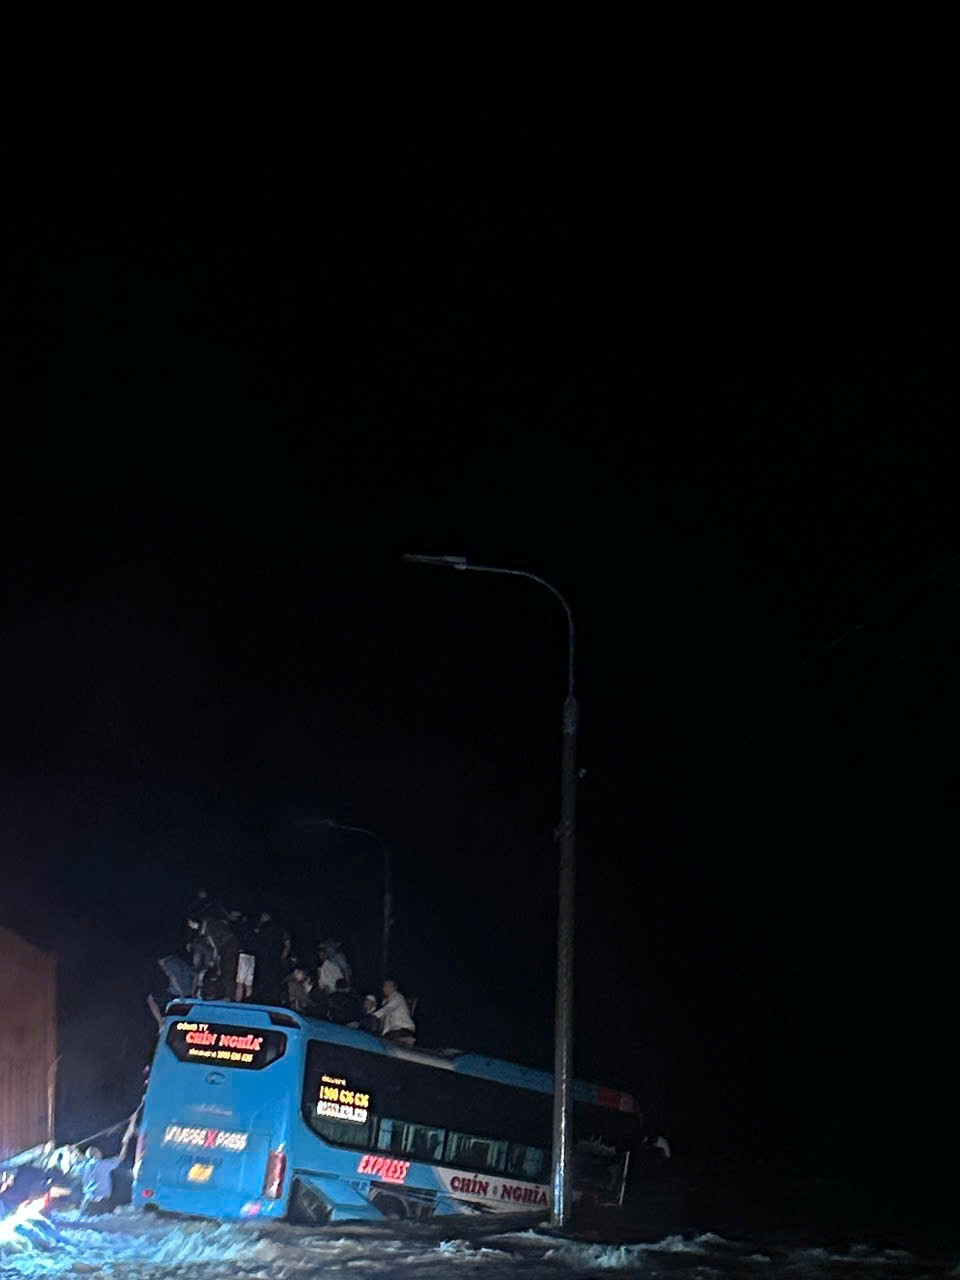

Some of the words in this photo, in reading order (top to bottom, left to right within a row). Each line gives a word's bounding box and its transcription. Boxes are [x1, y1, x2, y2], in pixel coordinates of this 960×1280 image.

[357, 1154, 410, 1180] EXPRESS
[450, 1174, 488, 1197] CHÍN
[501, 1184, 548, 1206] NGHĨA
